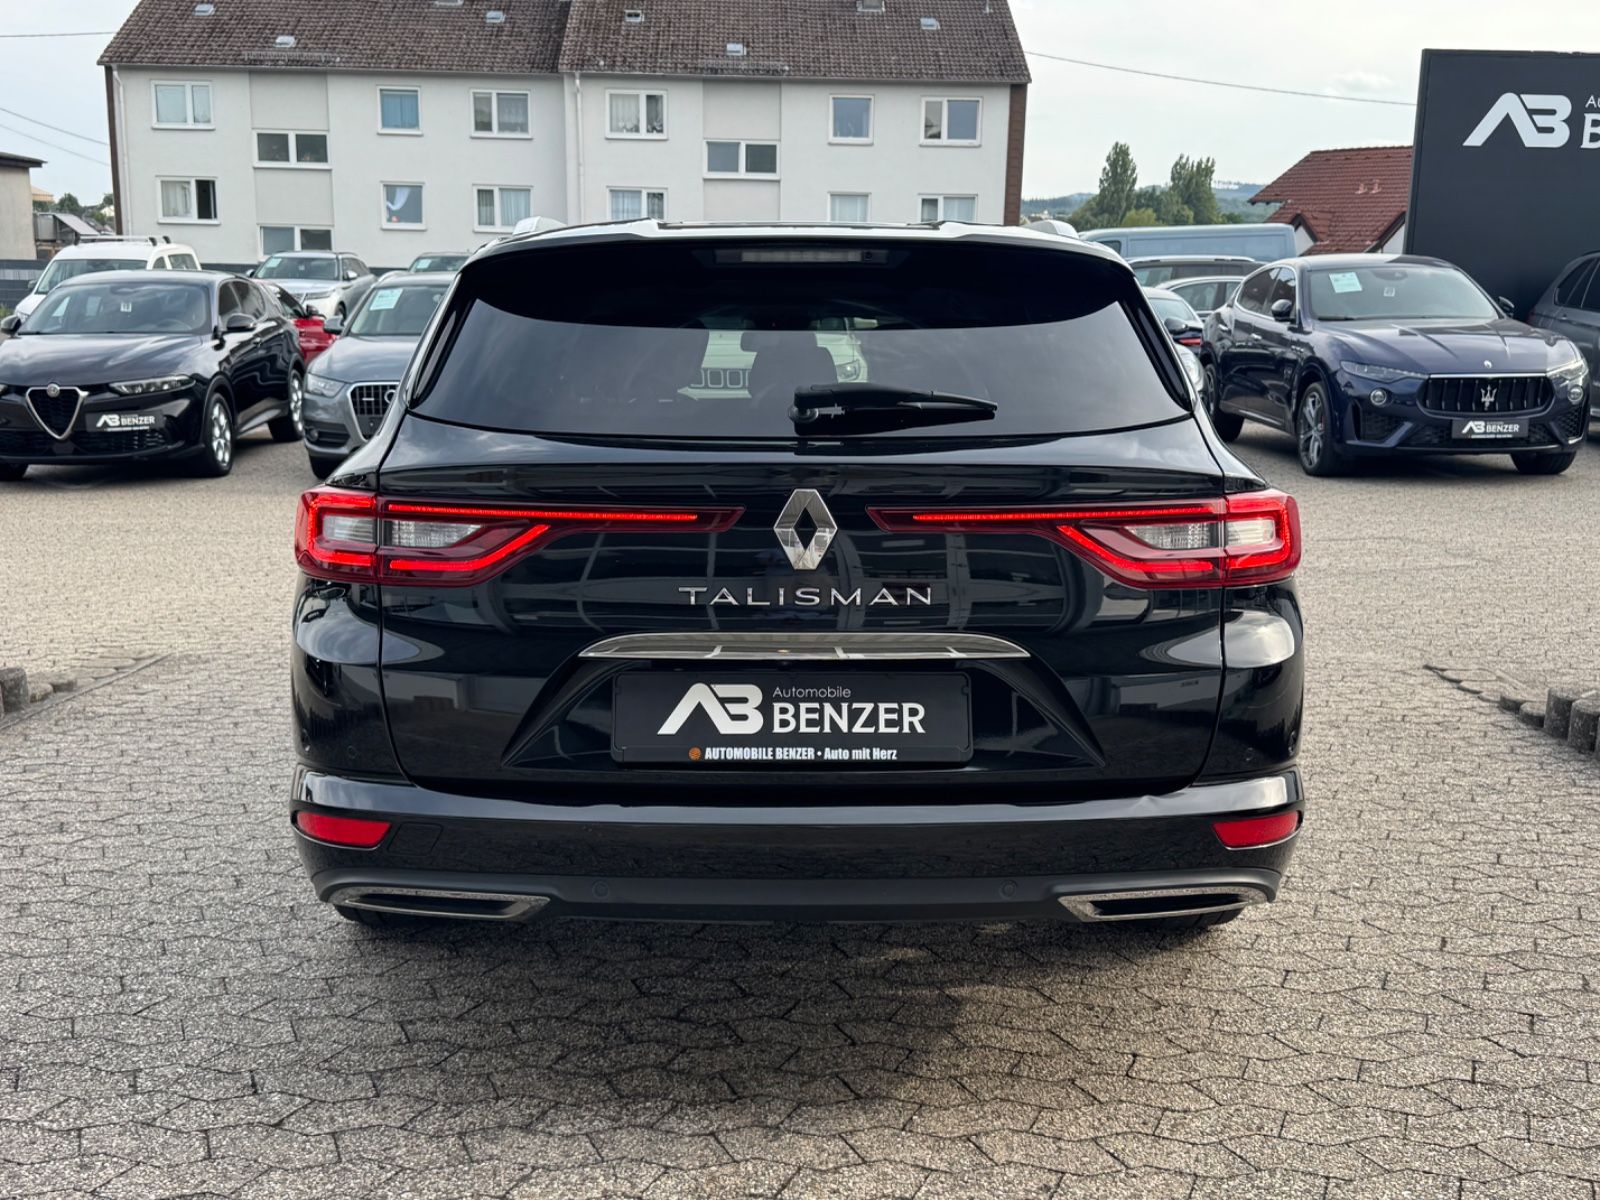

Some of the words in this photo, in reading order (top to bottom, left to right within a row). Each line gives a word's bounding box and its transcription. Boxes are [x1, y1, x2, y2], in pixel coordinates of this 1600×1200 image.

[121, 415, 155, 426] BENZER
[1486, 424, 1520, 433] BENZER
[678, 587, 932, 606] TALISMAN
[772, 686, 852, 699] Automobile
[657, 683, 764, 735] AB
[772, 702, 926, 734] BENZER
[704, 747, 774, 760] AUTOMOBILE
[776, 747, 815, 760] BENZER
[824, 747, 849, 760] Auto
[852, 747, 870, 760] mit
[873, 747, 898, 760] Herz
